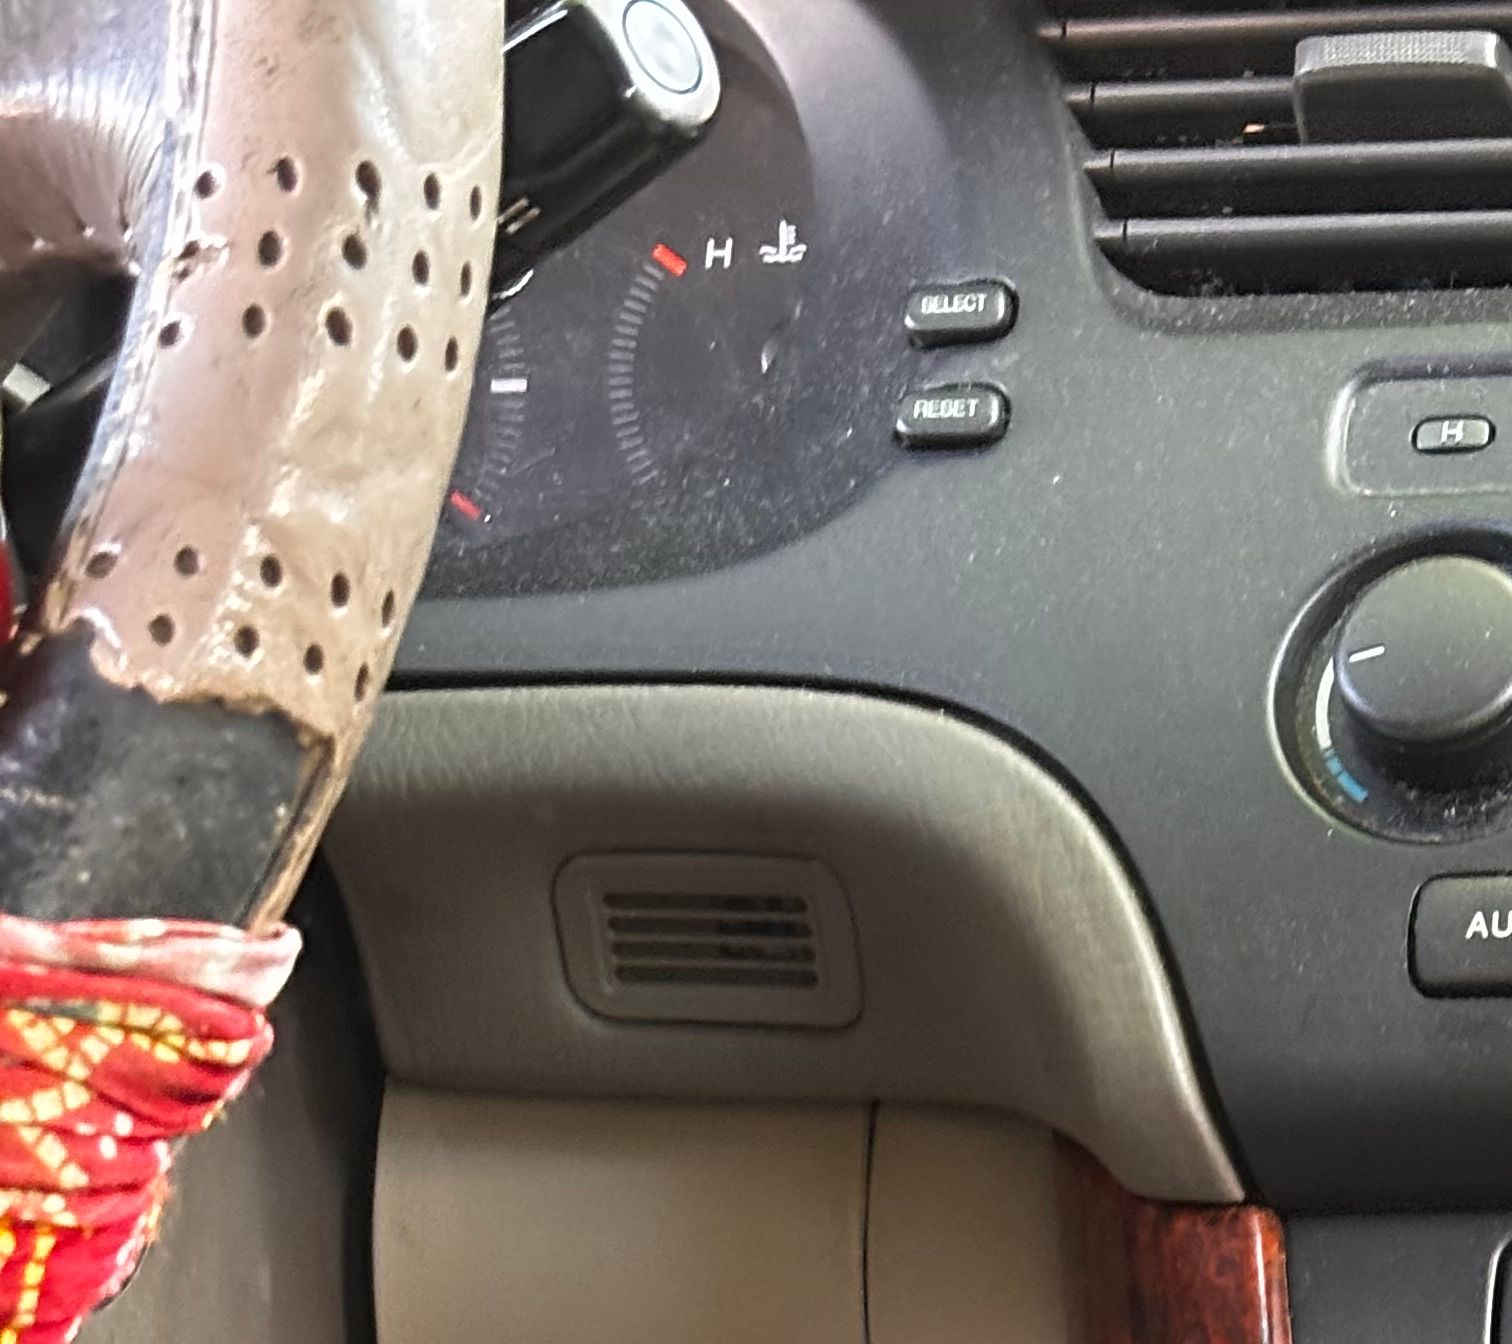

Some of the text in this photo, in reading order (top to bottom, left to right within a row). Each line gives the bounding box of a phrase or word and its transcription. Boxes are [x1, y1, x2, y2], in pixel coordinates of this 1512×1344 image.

[704, 237, 733, 270] H
[920, 293, 988, 315] SELECT
[913, 398, 979, 419] RESET
[1440, 420, 1464, 442] H
